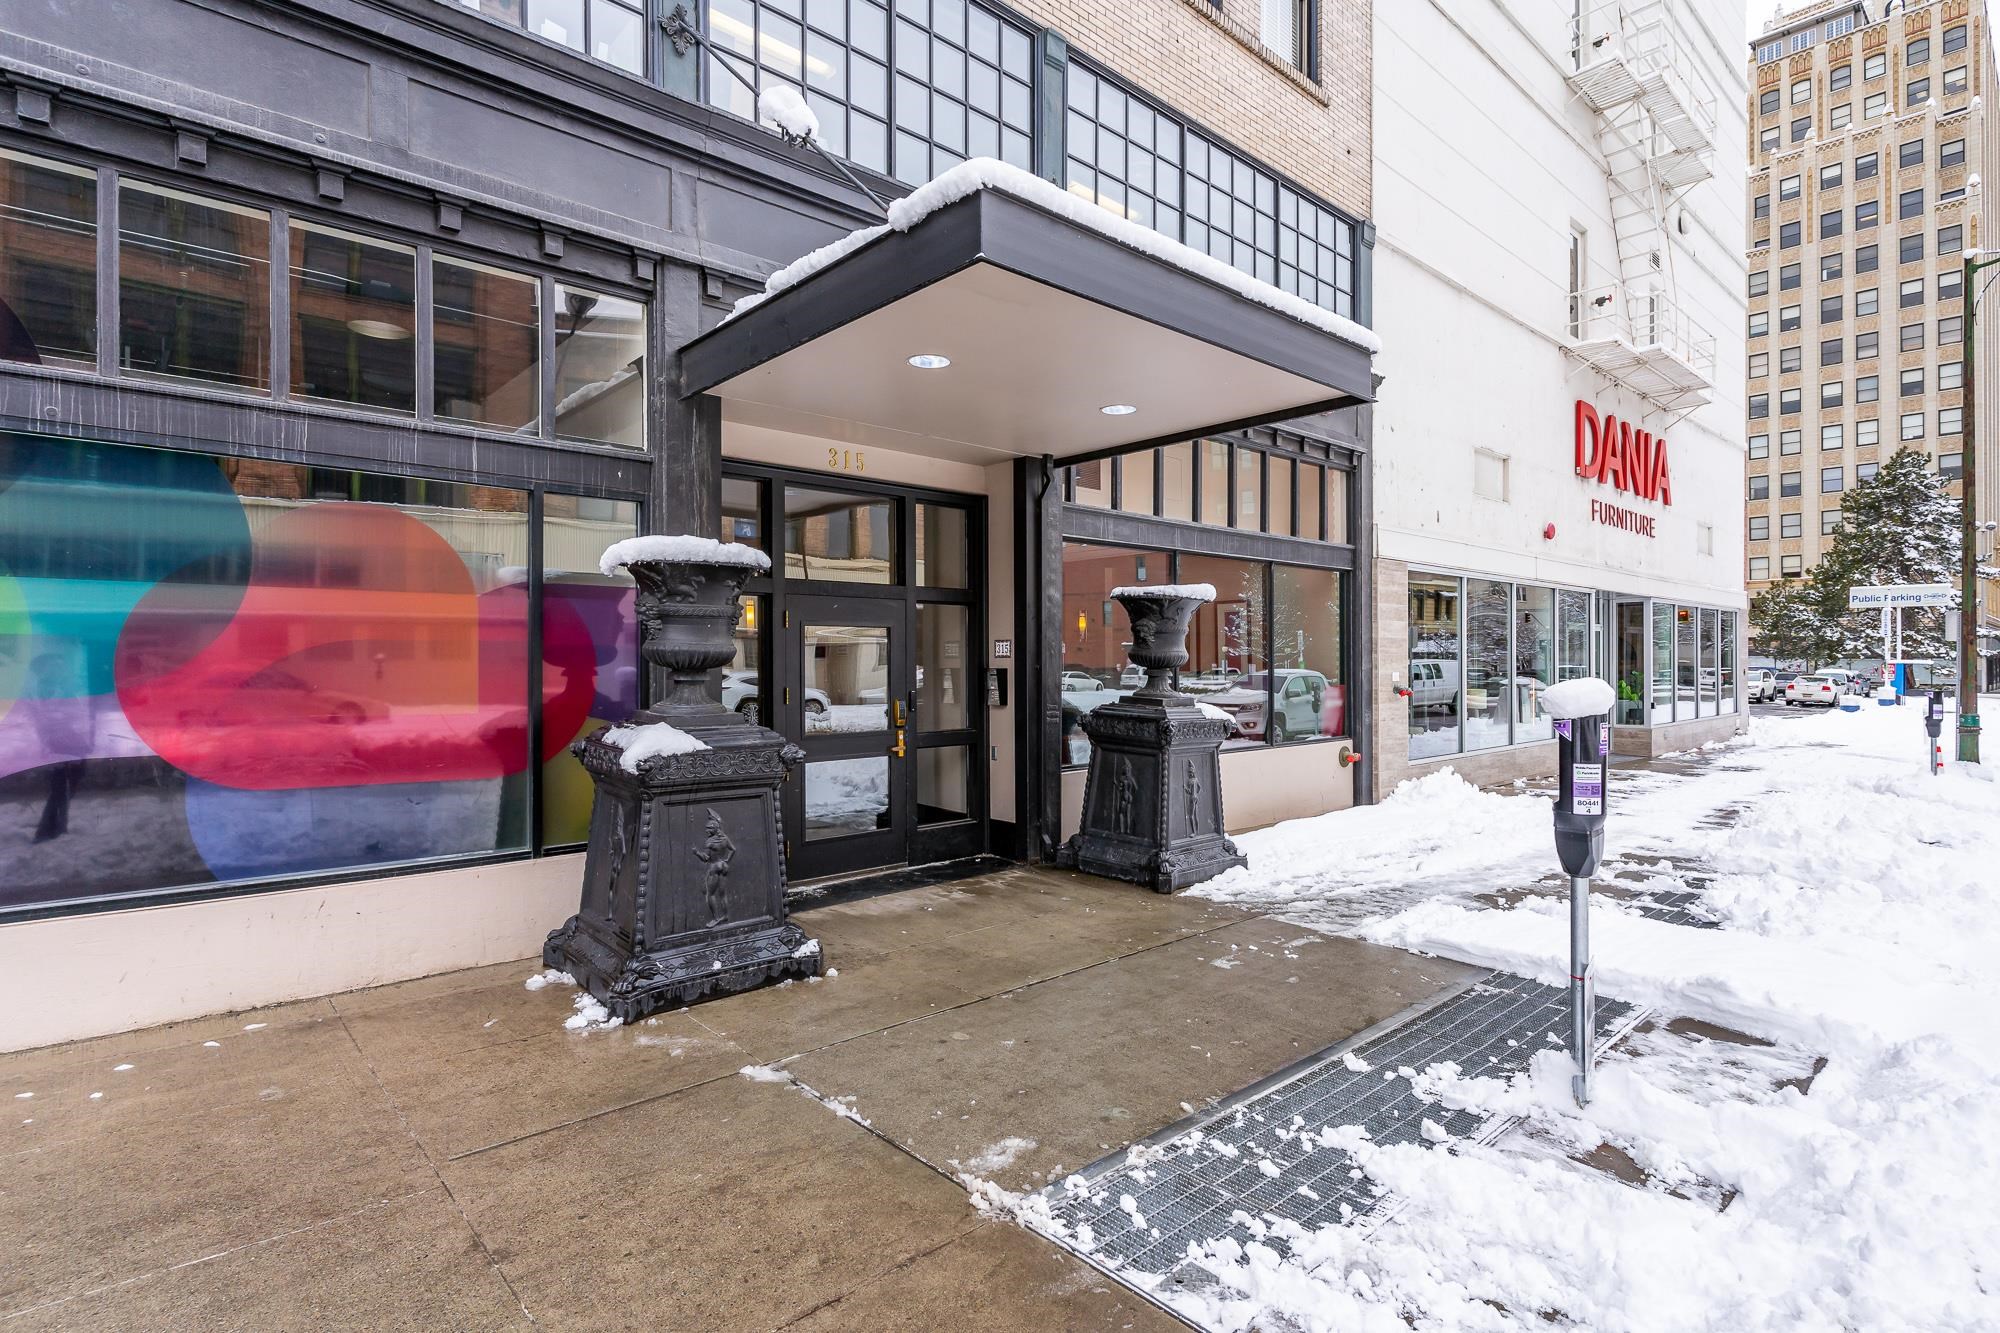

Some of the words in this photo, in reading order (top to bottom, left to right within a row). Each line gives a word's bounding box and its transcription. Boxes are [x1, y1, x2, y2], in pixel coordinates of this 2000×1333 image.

[828, 447, 865, 472] 315
[1575, 399, 1672, 506] DANIA
[1591, 498, 1656, 538] FURNITURE
[1851, 594, 1881, 603] Public
[1884, 593, 1922, 603] Parking
[996, 643, 1009, 654] 315
